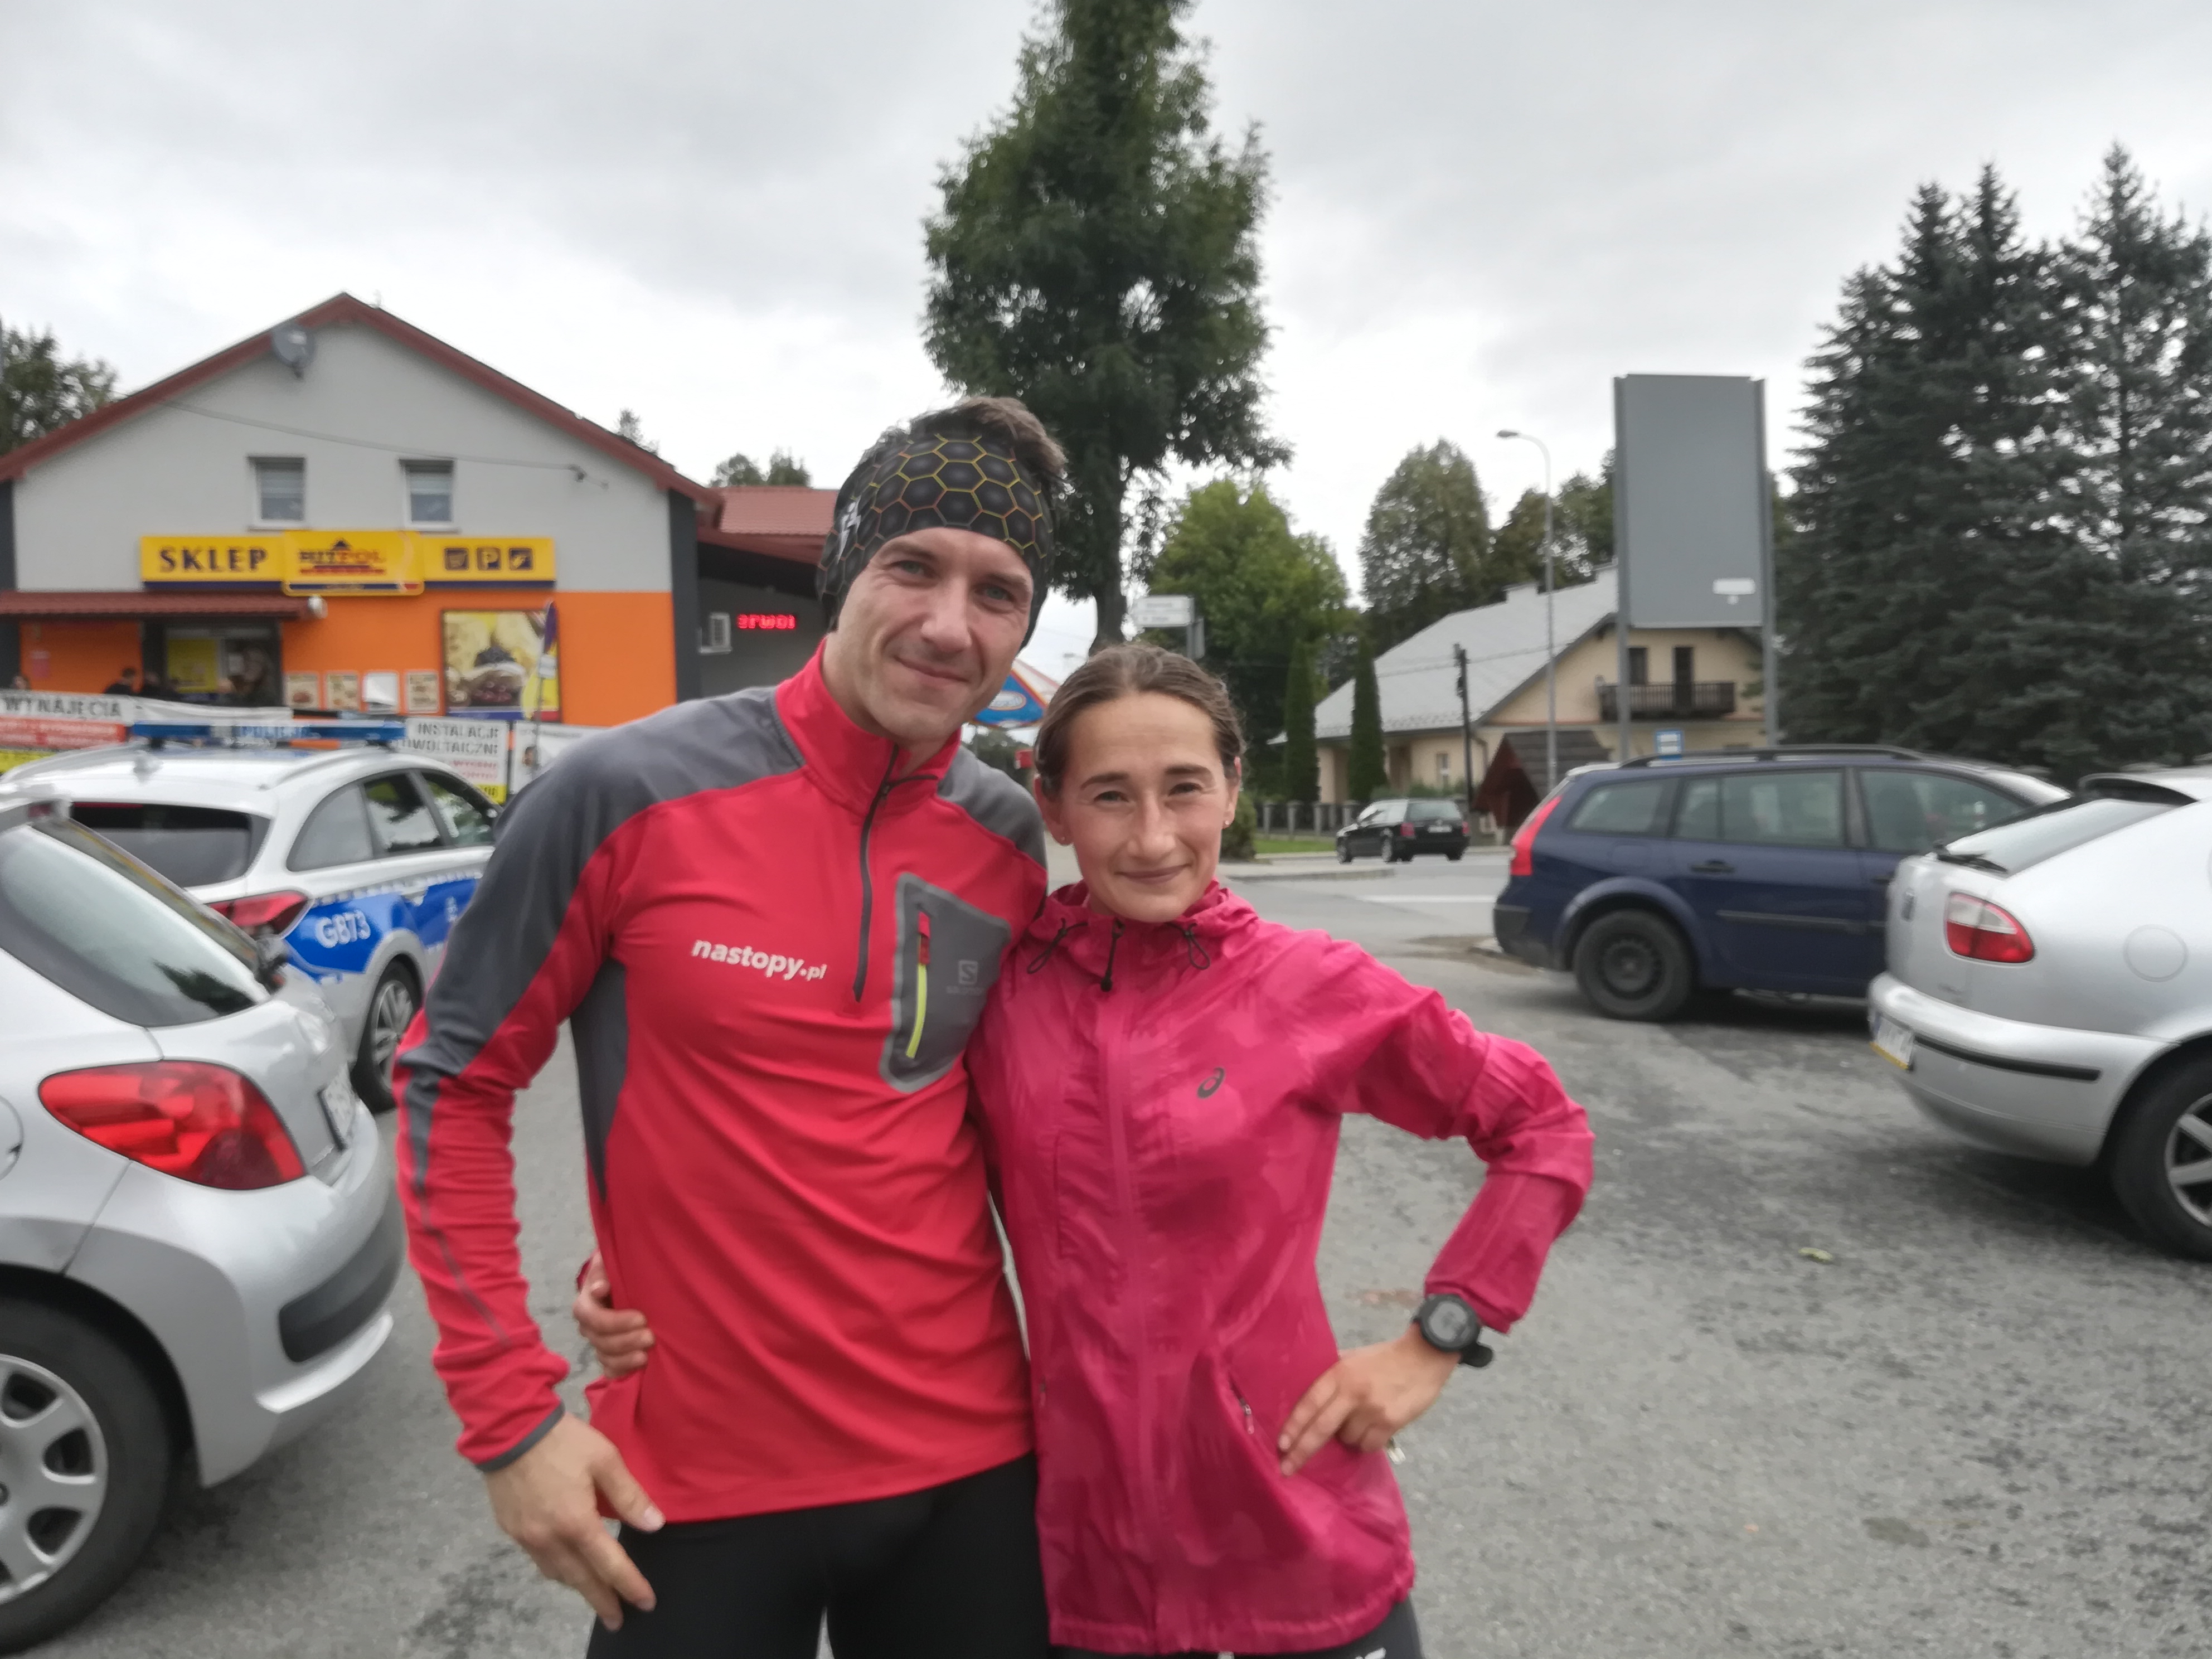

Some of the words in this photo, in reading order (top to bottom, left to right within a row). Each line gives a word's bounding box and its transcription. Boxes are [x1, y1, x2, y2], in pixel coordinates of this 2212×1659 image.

[158, 546, 268, 573] SKLEP
[316, 909, 371, 948] G873
[691, 939, 828, 981] nastopy.pl
